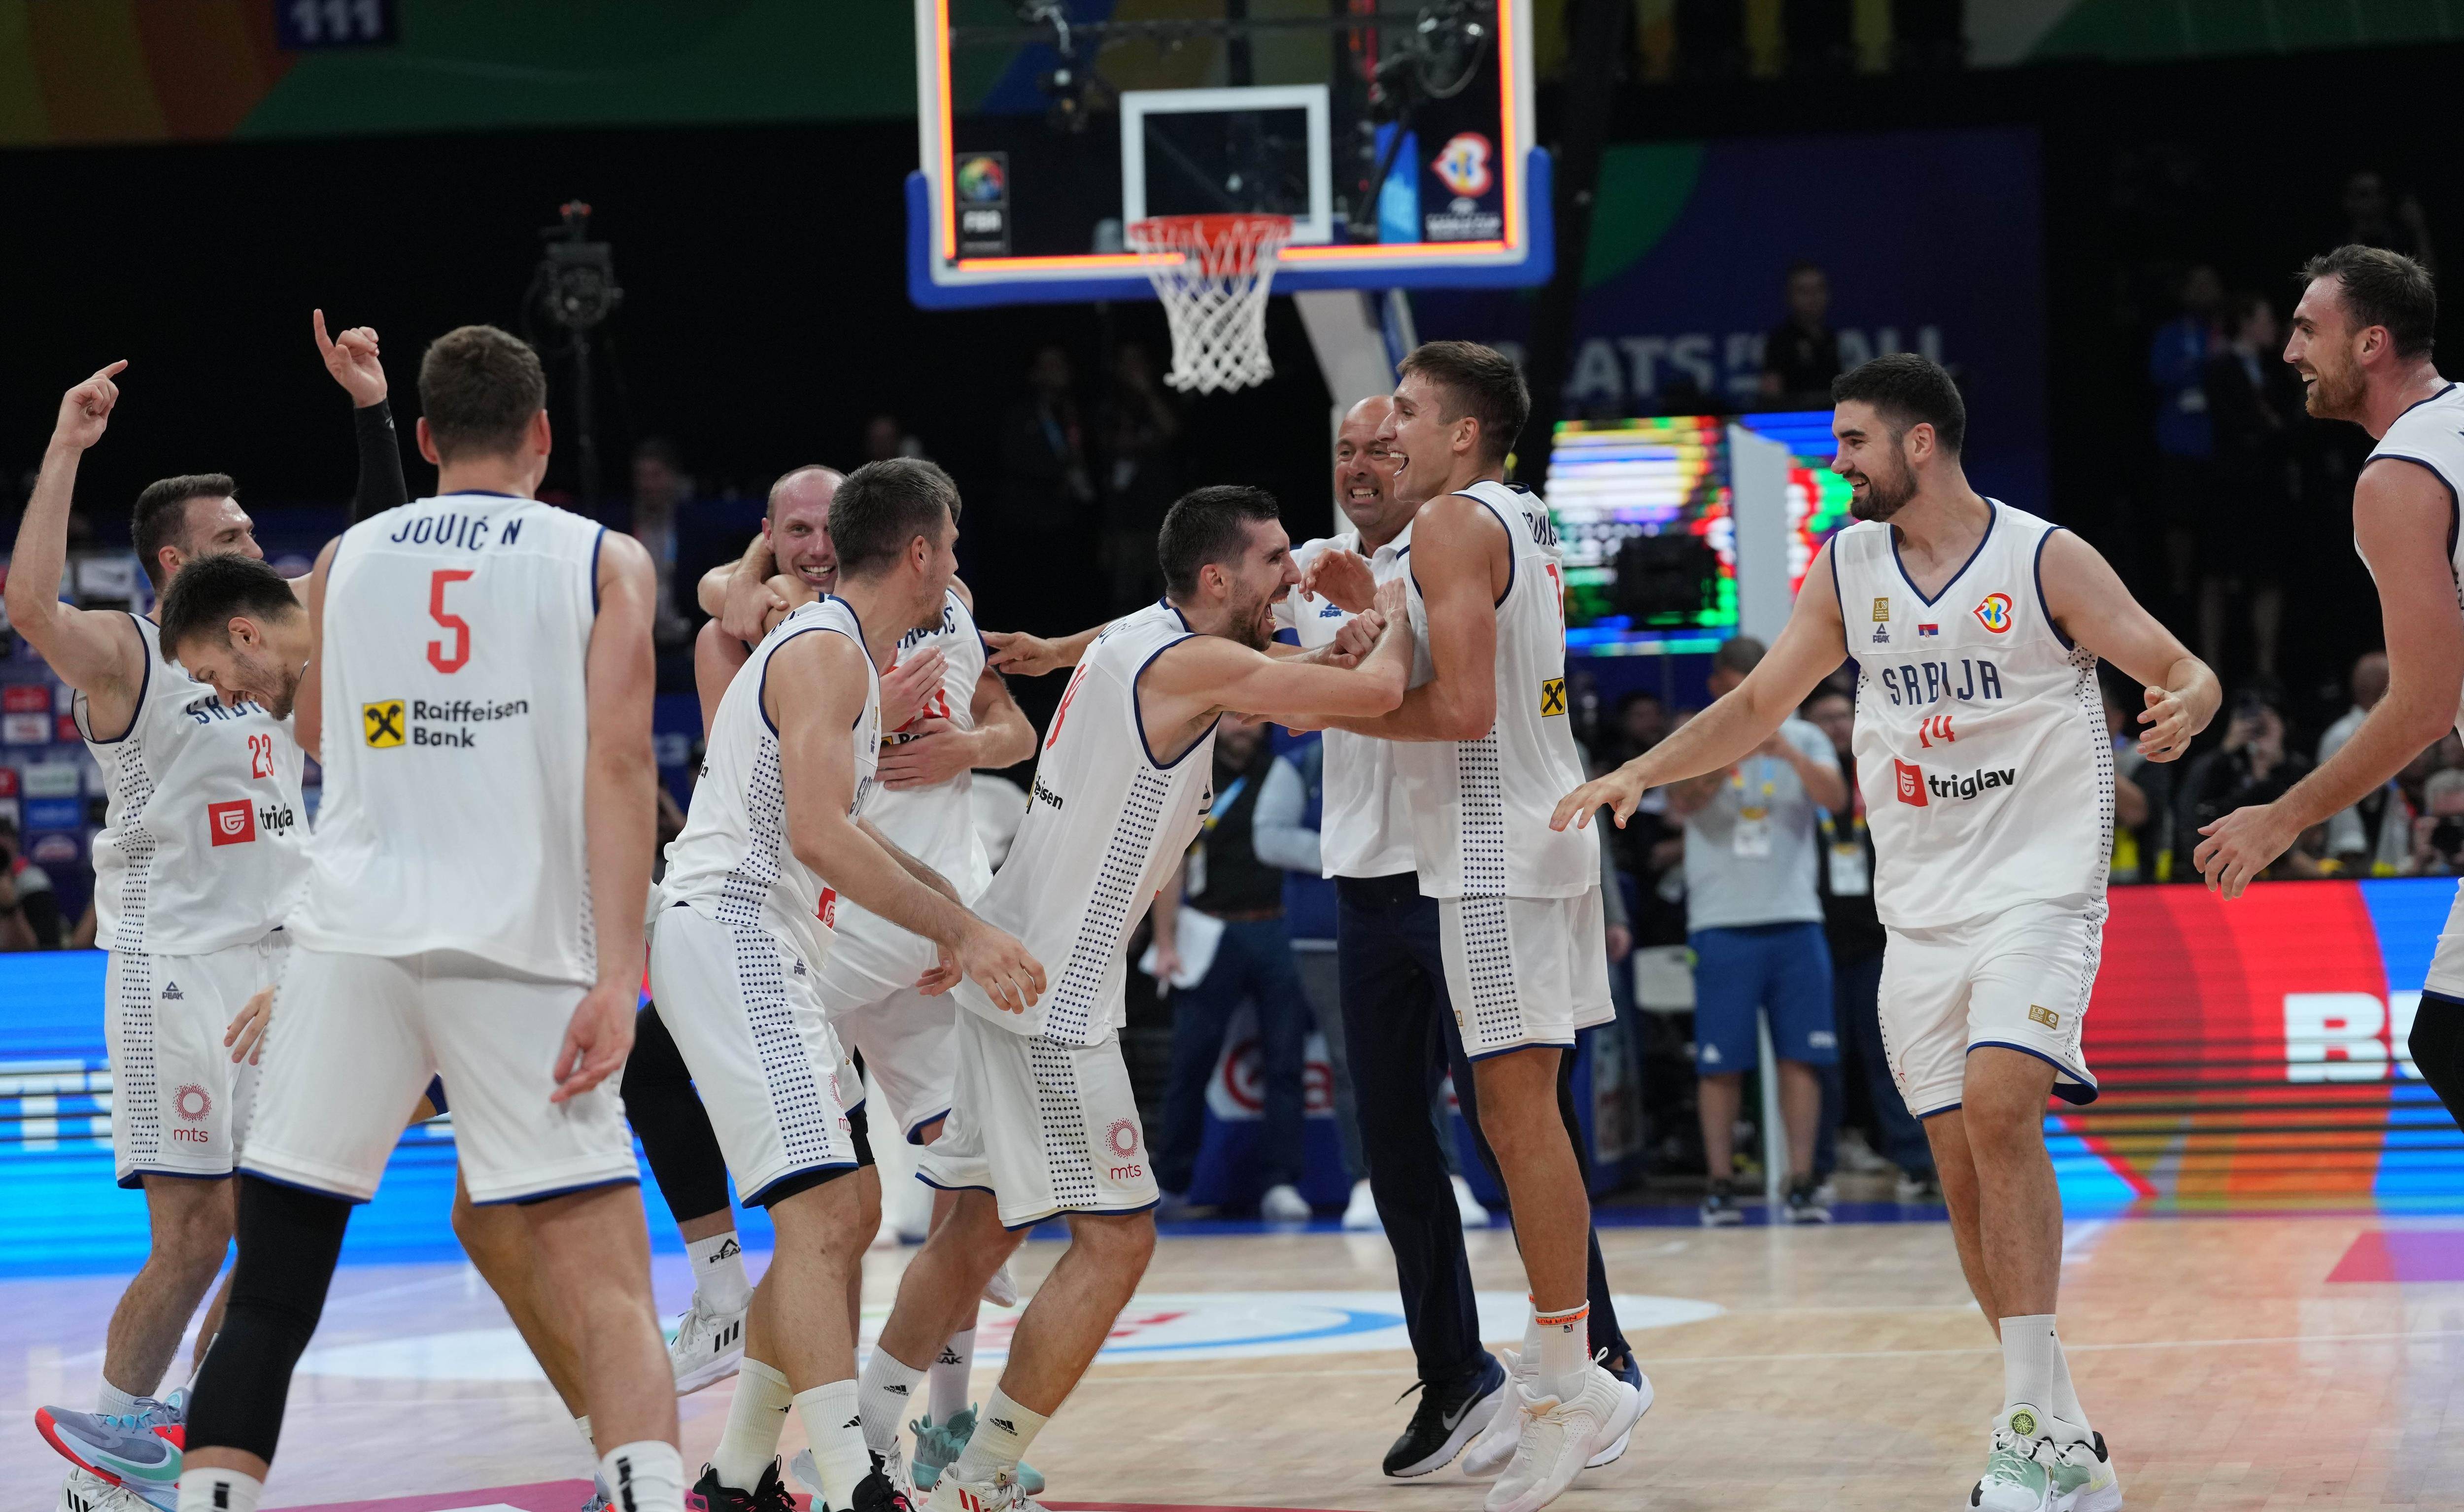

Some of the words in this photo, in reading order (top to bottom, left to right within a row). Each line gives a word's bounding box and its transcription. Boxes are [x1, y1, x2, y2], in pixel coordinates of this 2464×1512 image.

[501, 518, 523, 545] N
[427, 569, 475, 673] 5
[1873, 635, 1890, 643] PEAK
[1882, 659, 2002, 705] SRBIJA
[413, 699, 528, 722] Raiffeisen
[413, 726, 476, 747] Bank
[1919, 715, 1955, 748] 14
[248, 733, 274, 779] 23
[1928, 768, 2016, 800] triglav
[162, 991, 184, 1000] PEAK
[174, 1127, 208, 1142] mts
[1110, 1163, 1142, 1179] mts
[935, 1356, 963, 1365] EAK
[884, 1386, 909, 1396] adidas
[990, 1418, 1018, 1436] adidas
